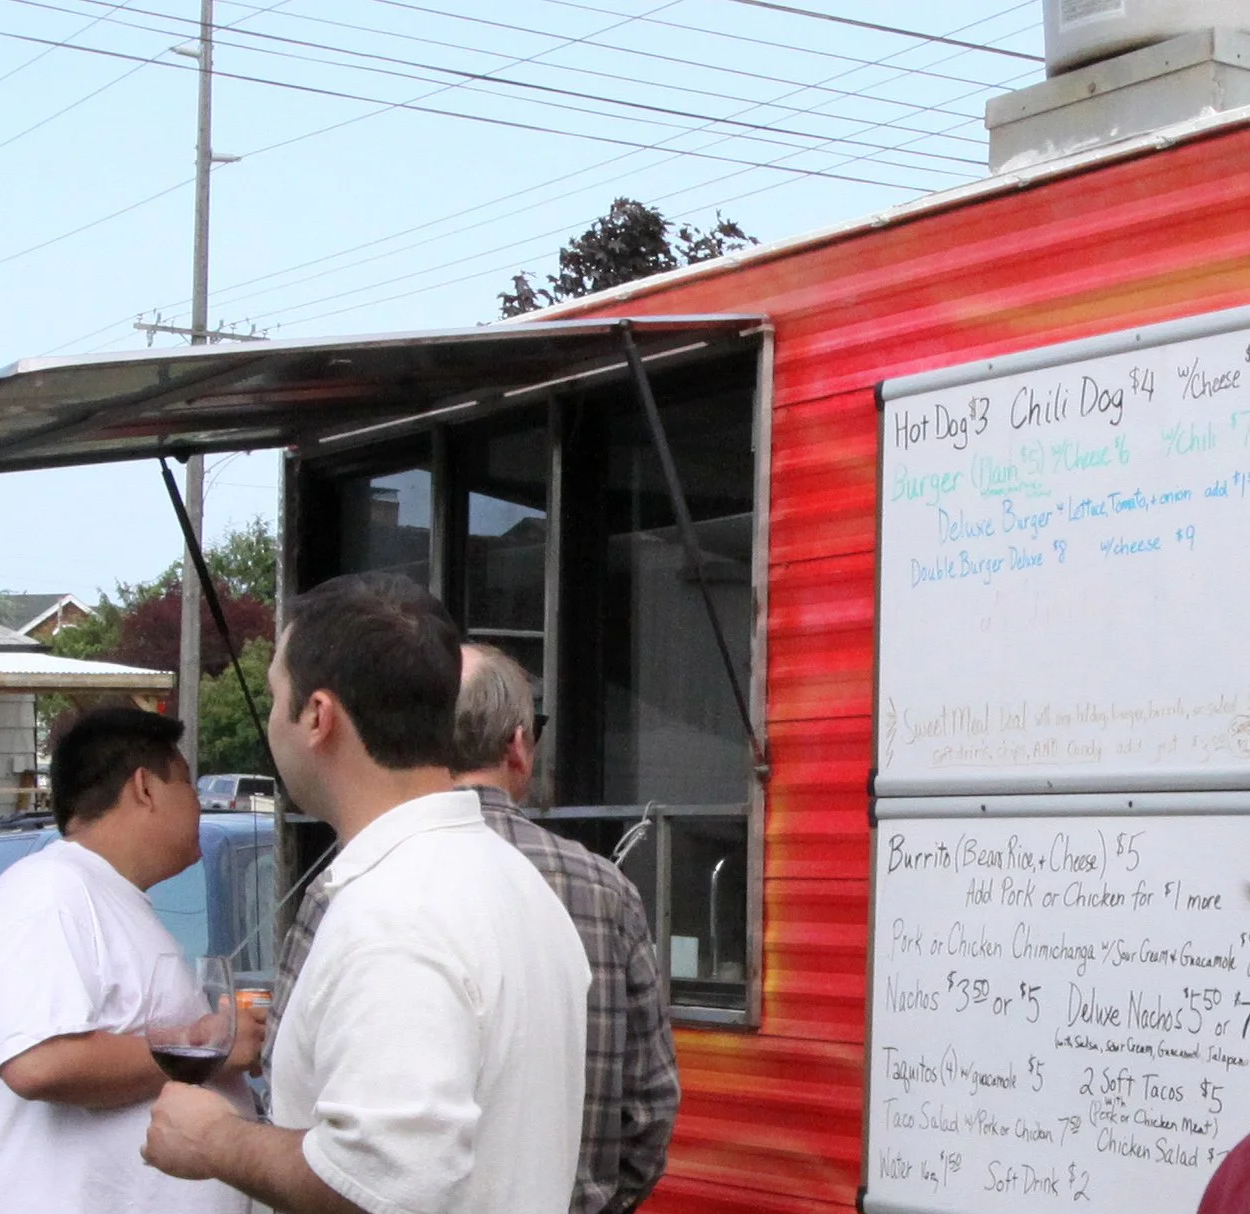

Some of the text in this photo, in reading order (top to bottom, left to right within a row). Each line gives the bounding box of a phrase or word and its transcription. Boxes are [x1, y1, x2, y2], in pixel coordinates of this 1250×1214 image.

[895, 411, 929, 450] Hot
[935, 404, 968, 450] Dog
[1010, 382, 1069, 429] Chili
[1080, 376, 1124, 425] Dog
[1129, 366, 1154, 402] $4
[891, 465, 963, 506] Burger
[938, 507, 996, 545] Deluxe
[1002, 499, 1053, 540] Burger
[911, 556, 956, 588] Double
[959, 550, 1005, 585] Burger
[1008, 546, 1043, 571] Deluxe
[1176, 525, 1195, 550] $9
[888, 834, 950, 874] Burrito
[1117, 830, 1146, 872] $5
[965, 877, 994, 908] Add
[1042, 892, 1060, 908] or
[1063, 881, 1125, 908] Chicken
[1131, 879, 1154, 911] for
[1187, 893, 1222, 911] more
[891, 917, 922, 961] Pork
[930, 938, 944, 956] or
[948, 920, 1002, 957] Chicken
[1012, 921, 1095, 977] Chimichanga
[886, 972, 939, 1013] Nachos
[992, 996, 1013, 1015] or
[1019, 981, 1042, 1023] $5
[1067, 981, 1121, 1027] Deluxe
[1128, 990, 1183, 1032] Nachos
[1215, 1019, 1231, 1036] or
[882, 1046, 938, 1094] Taquitos
[941, 1043, 958, 1087] (4)
[1028, 1054, 1045, 1092] $5
[1079, 1066, 1224, 1114] 2 Soft Tacos $5
[883, 1097, 915, 1131] Taco
[918, 1100, 960, 1133] Salad
[1134, 1108, 1178, 1132] Chicken
[879, 1147, 912, 1180] Water
[1097, 1127, 1150, 1161] Chicken
[1155, 1137, 1198, 1167] Salad
[984, 1160, 1090, 1201] Soft Drink $2
